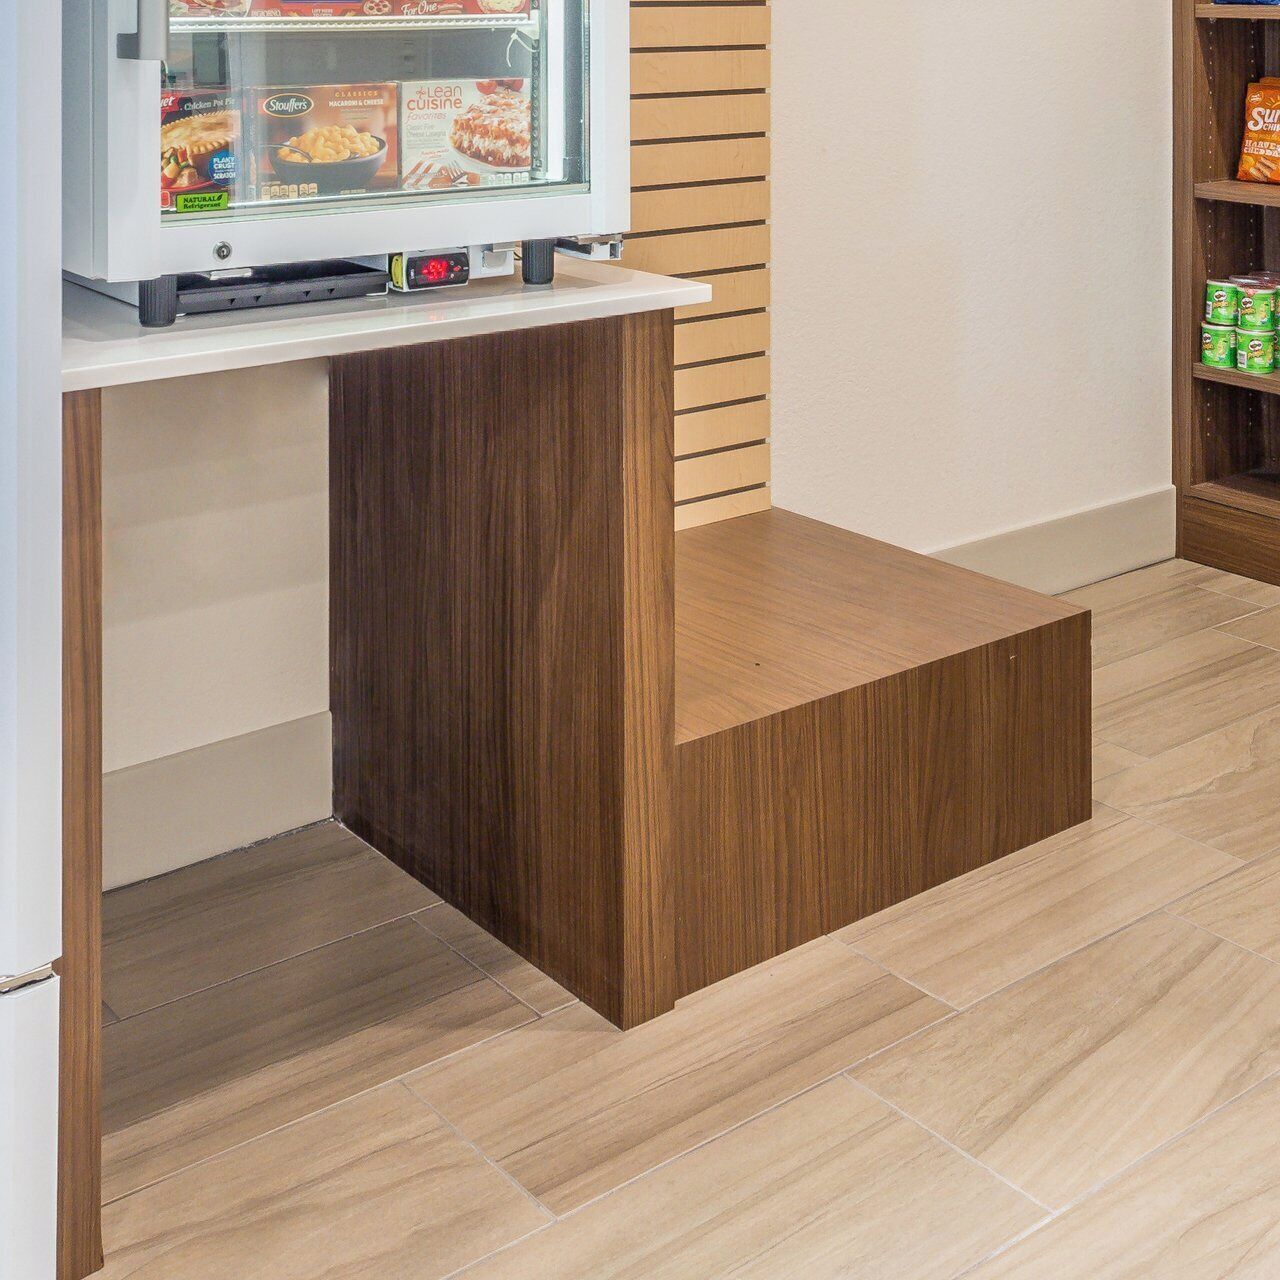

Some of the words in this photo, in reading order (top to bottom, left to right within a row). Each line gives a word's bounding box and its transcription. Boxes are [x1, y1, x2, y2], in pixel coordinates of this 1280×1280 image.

[419, 1, 438, 14] One
[334, 90, 379, 99] CLASSICS
[184, 100, 212, 111] Chicken
[213, 98, 224, 107] Pot
[225, 96, 235, 106] Pie
[269, 98, 308, 113] Stouffer's
[328, 100, 358, 108] MACARONI
[363, 98, 385, 106] CHEESE
[183, 196, 217, 204] NATURAL
[183, 202, 221, 210] Refrigerant
